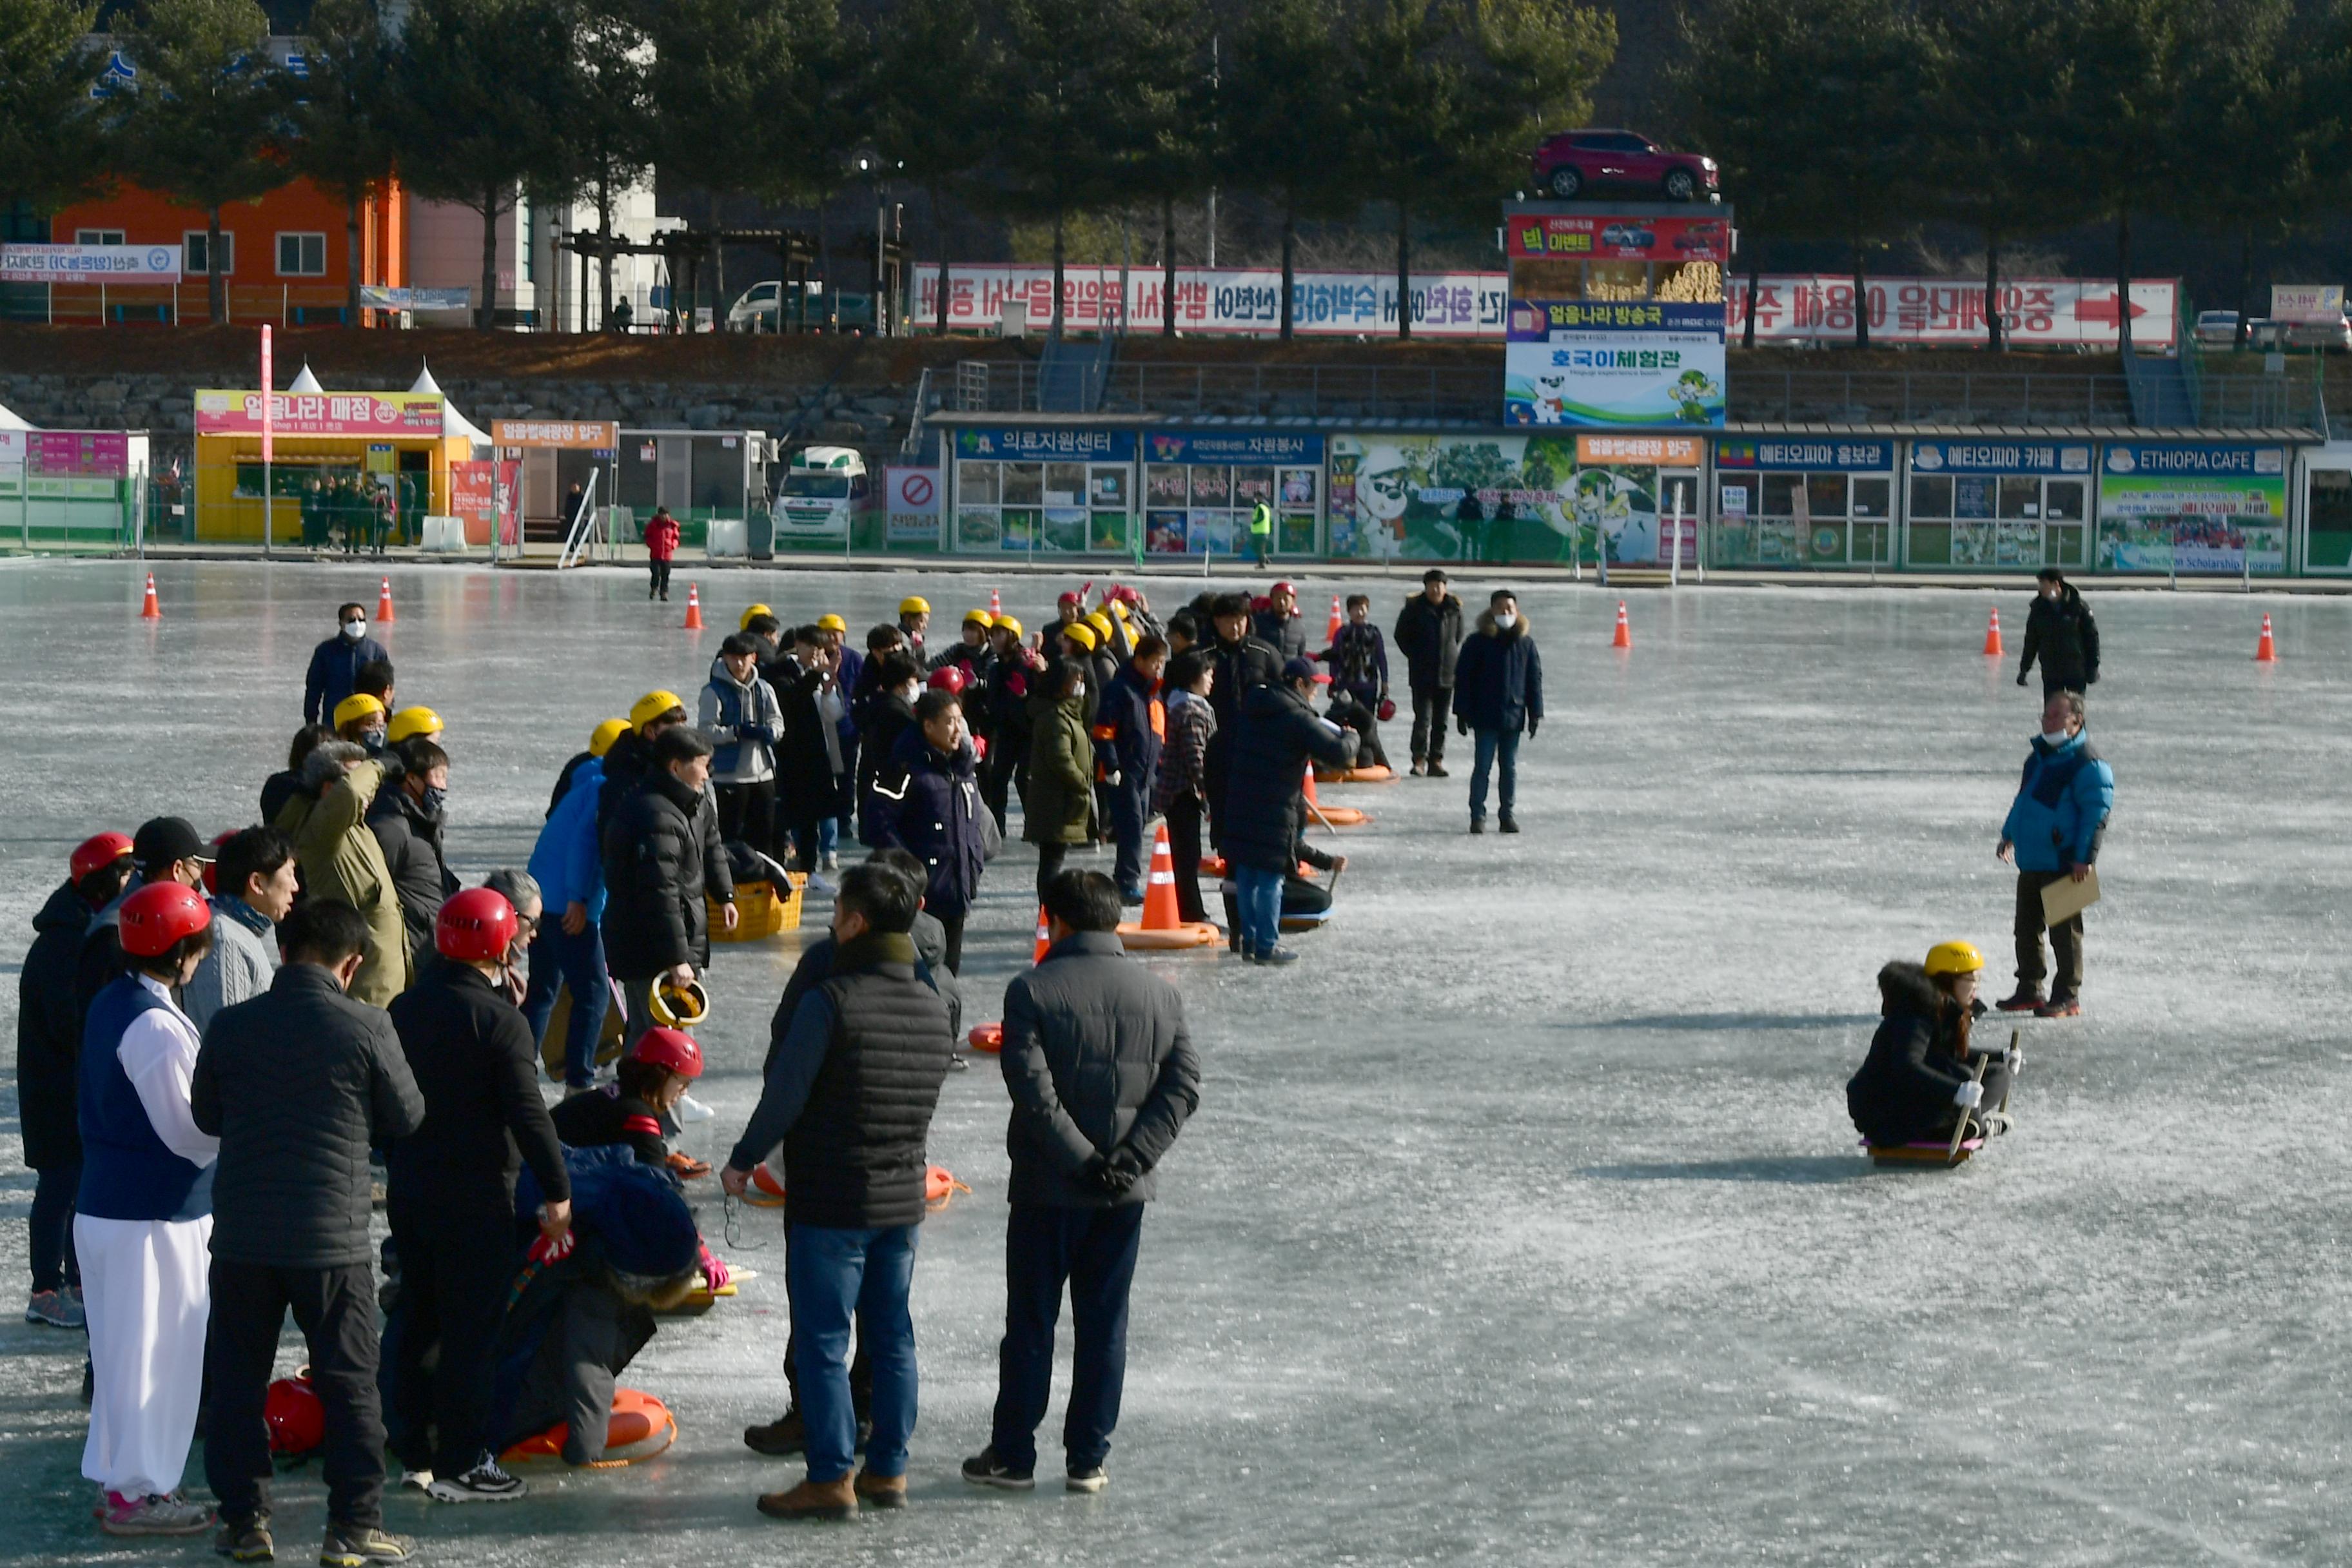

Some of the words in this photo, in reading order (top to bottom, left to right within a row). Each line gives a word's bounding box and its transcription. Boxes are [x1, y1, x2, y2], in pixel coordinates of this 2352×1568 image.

[1549, 233, 1592, 251] 이벤트
[1549, 305, 1612, 325] 얼음나라
[1614, 306, 1663, 326] 방송국
[1551, 349, 1681, 369] 호국이체험관
[329, 397, 371, 422] 매점
[578, 424, 603, 441] 입구
[1003, 430, 1112, 453] 의료지원센터
[1248, 436, 1304, 453] 자원봉사
[1667, 440, 1692, 458] 입구
[1759, 444, 1832, 464] 에티오피아
[1837, 444, 1881, 465] 홍보관
[1948, 446, 2021, 467] 에티오피아
[2024, 446, 2054, 468] 카페
[2140, 451, 2208, 469] ETHIOPIA
[2211, 451, 2250, 469] CAFE
[2186, 555, 2240, 571] Scholarship
